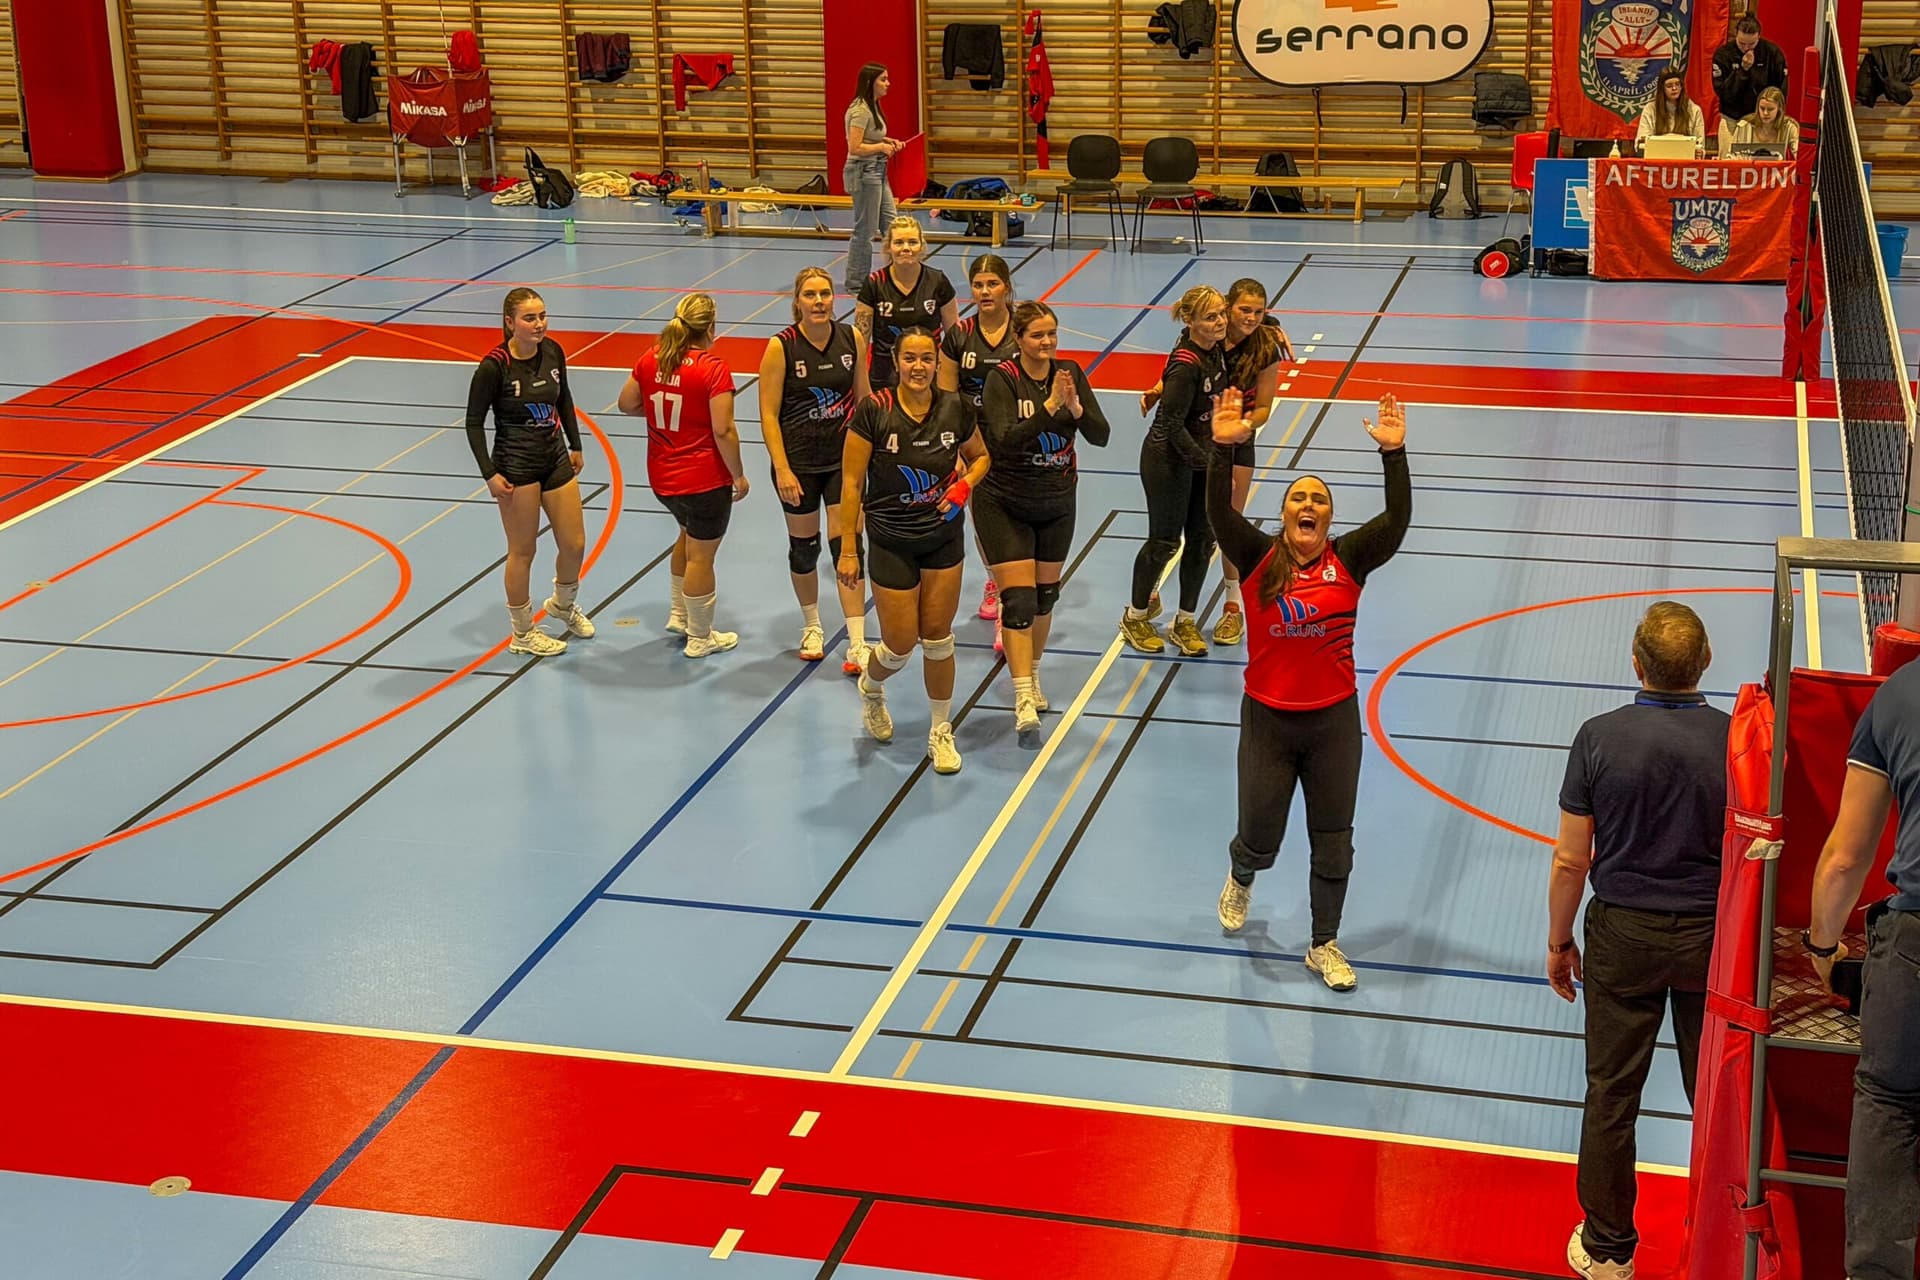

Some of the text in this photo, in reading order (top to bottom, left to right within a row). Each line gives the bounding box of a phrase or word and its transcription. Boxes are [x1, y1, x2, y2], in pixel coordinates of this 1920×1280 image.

[1255, 24, 1469, 54] serrano
[1675, 199, 1730, 226] UMFA
[877, 301, 894, 317] 12
[794, 360, 808, 378] 5
[961, 351, 977, 369] 16
[649, 390, 683, 432] 17
[1017, 398, 1035, 419] 10
[886, 433, 900, 454] 4
[1269, 623, 1327, 638] G.RUN
